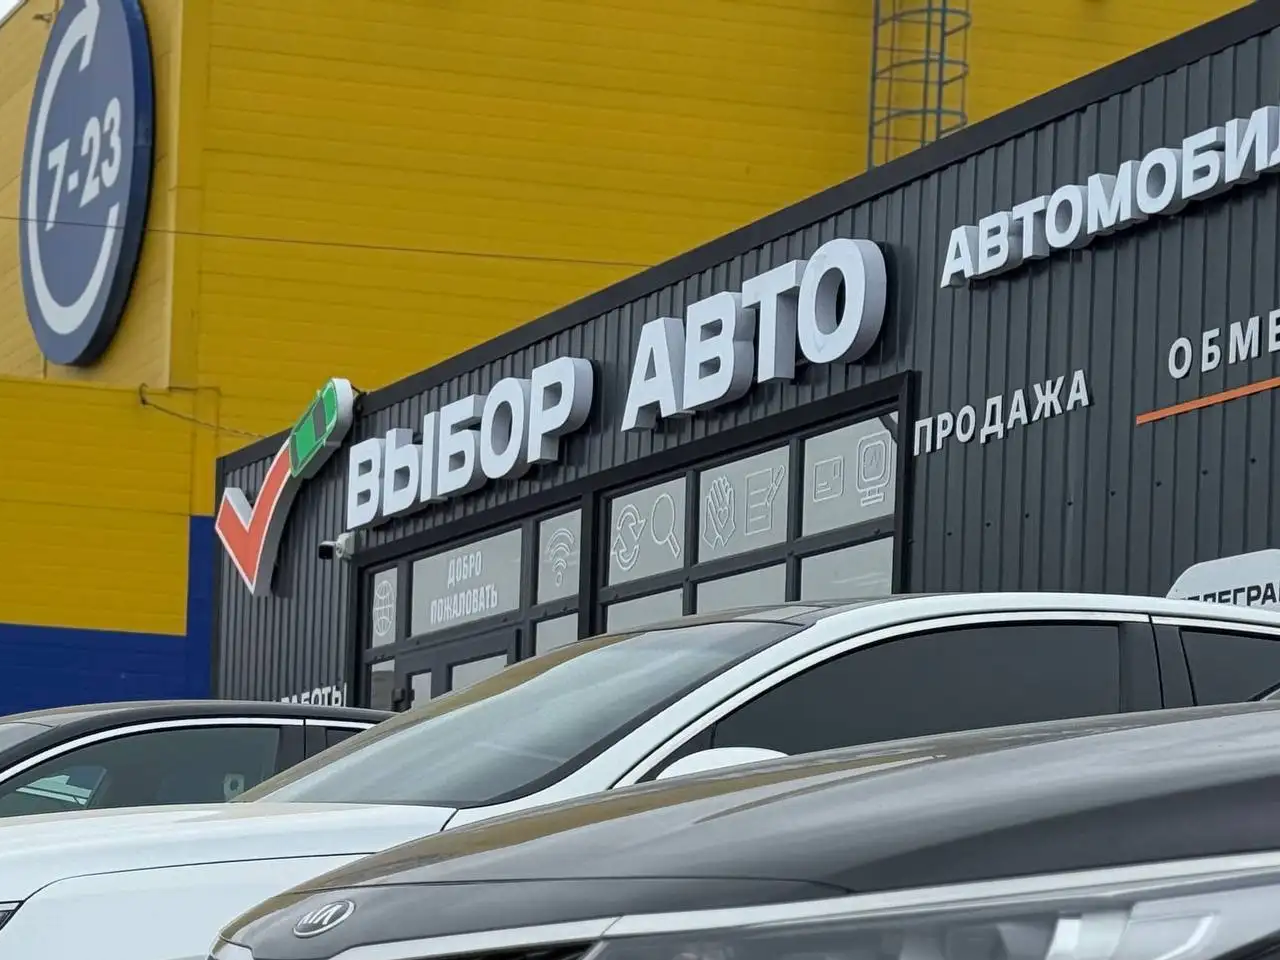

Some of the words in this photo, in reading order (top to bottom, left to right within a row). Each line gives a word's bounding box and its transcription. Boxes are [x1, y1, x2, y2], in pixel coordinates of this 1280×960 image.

[44, 97, 122, 232] 7-23
[940, 105, 1280, 288] АВТОМОБИ
[346, 356, 594, 531] ВЫБОР
[621, 238, 888, 432] АВТО
[913, 369, 1091, 457] ПРОДАЖА
[430, 583, 498, 625] ПОЖАЛОВАТЬ
[447, 550, 482, 589] ДОБРО
